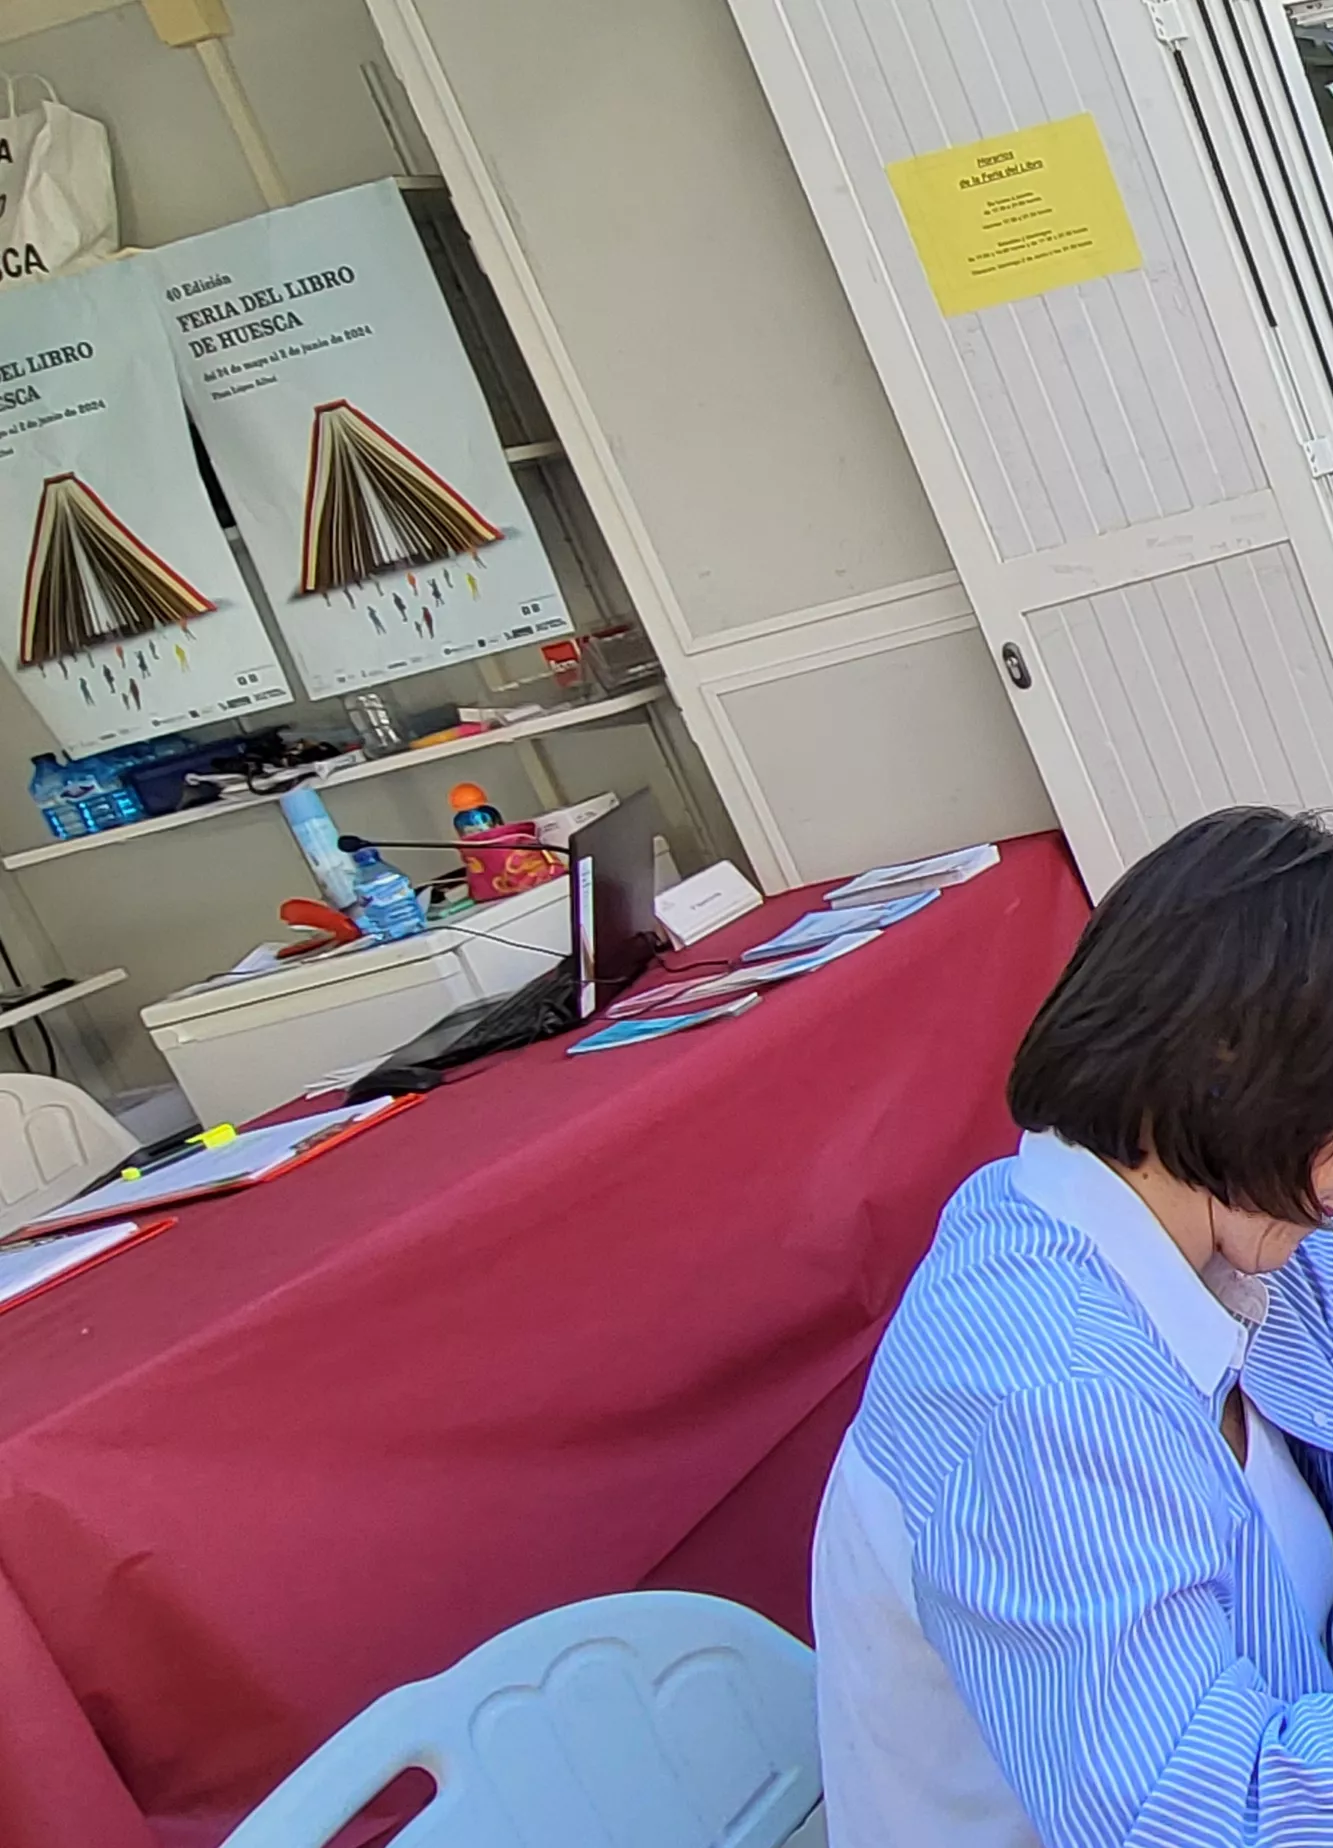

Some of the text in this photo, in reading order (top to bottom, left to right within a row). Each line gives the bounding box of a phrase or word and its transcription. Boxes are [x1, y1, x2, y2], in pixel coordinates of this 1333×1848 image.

[976, 151, 1014, 168] Horarios
[981, 168, 1004, 183] Feria
[1020, 159, 1043, 174] Libro
[0, 243, 49, 281] CA
[166, 273, 232, 302] 40 Edición
[176, 266, 356, 333] FERIA DEL LIBRO
[188, 311, 304, 358] DE HUESCA
[0, 341, 94, 382] EL LIBRO
[0, 385, 41, 412] SCA
